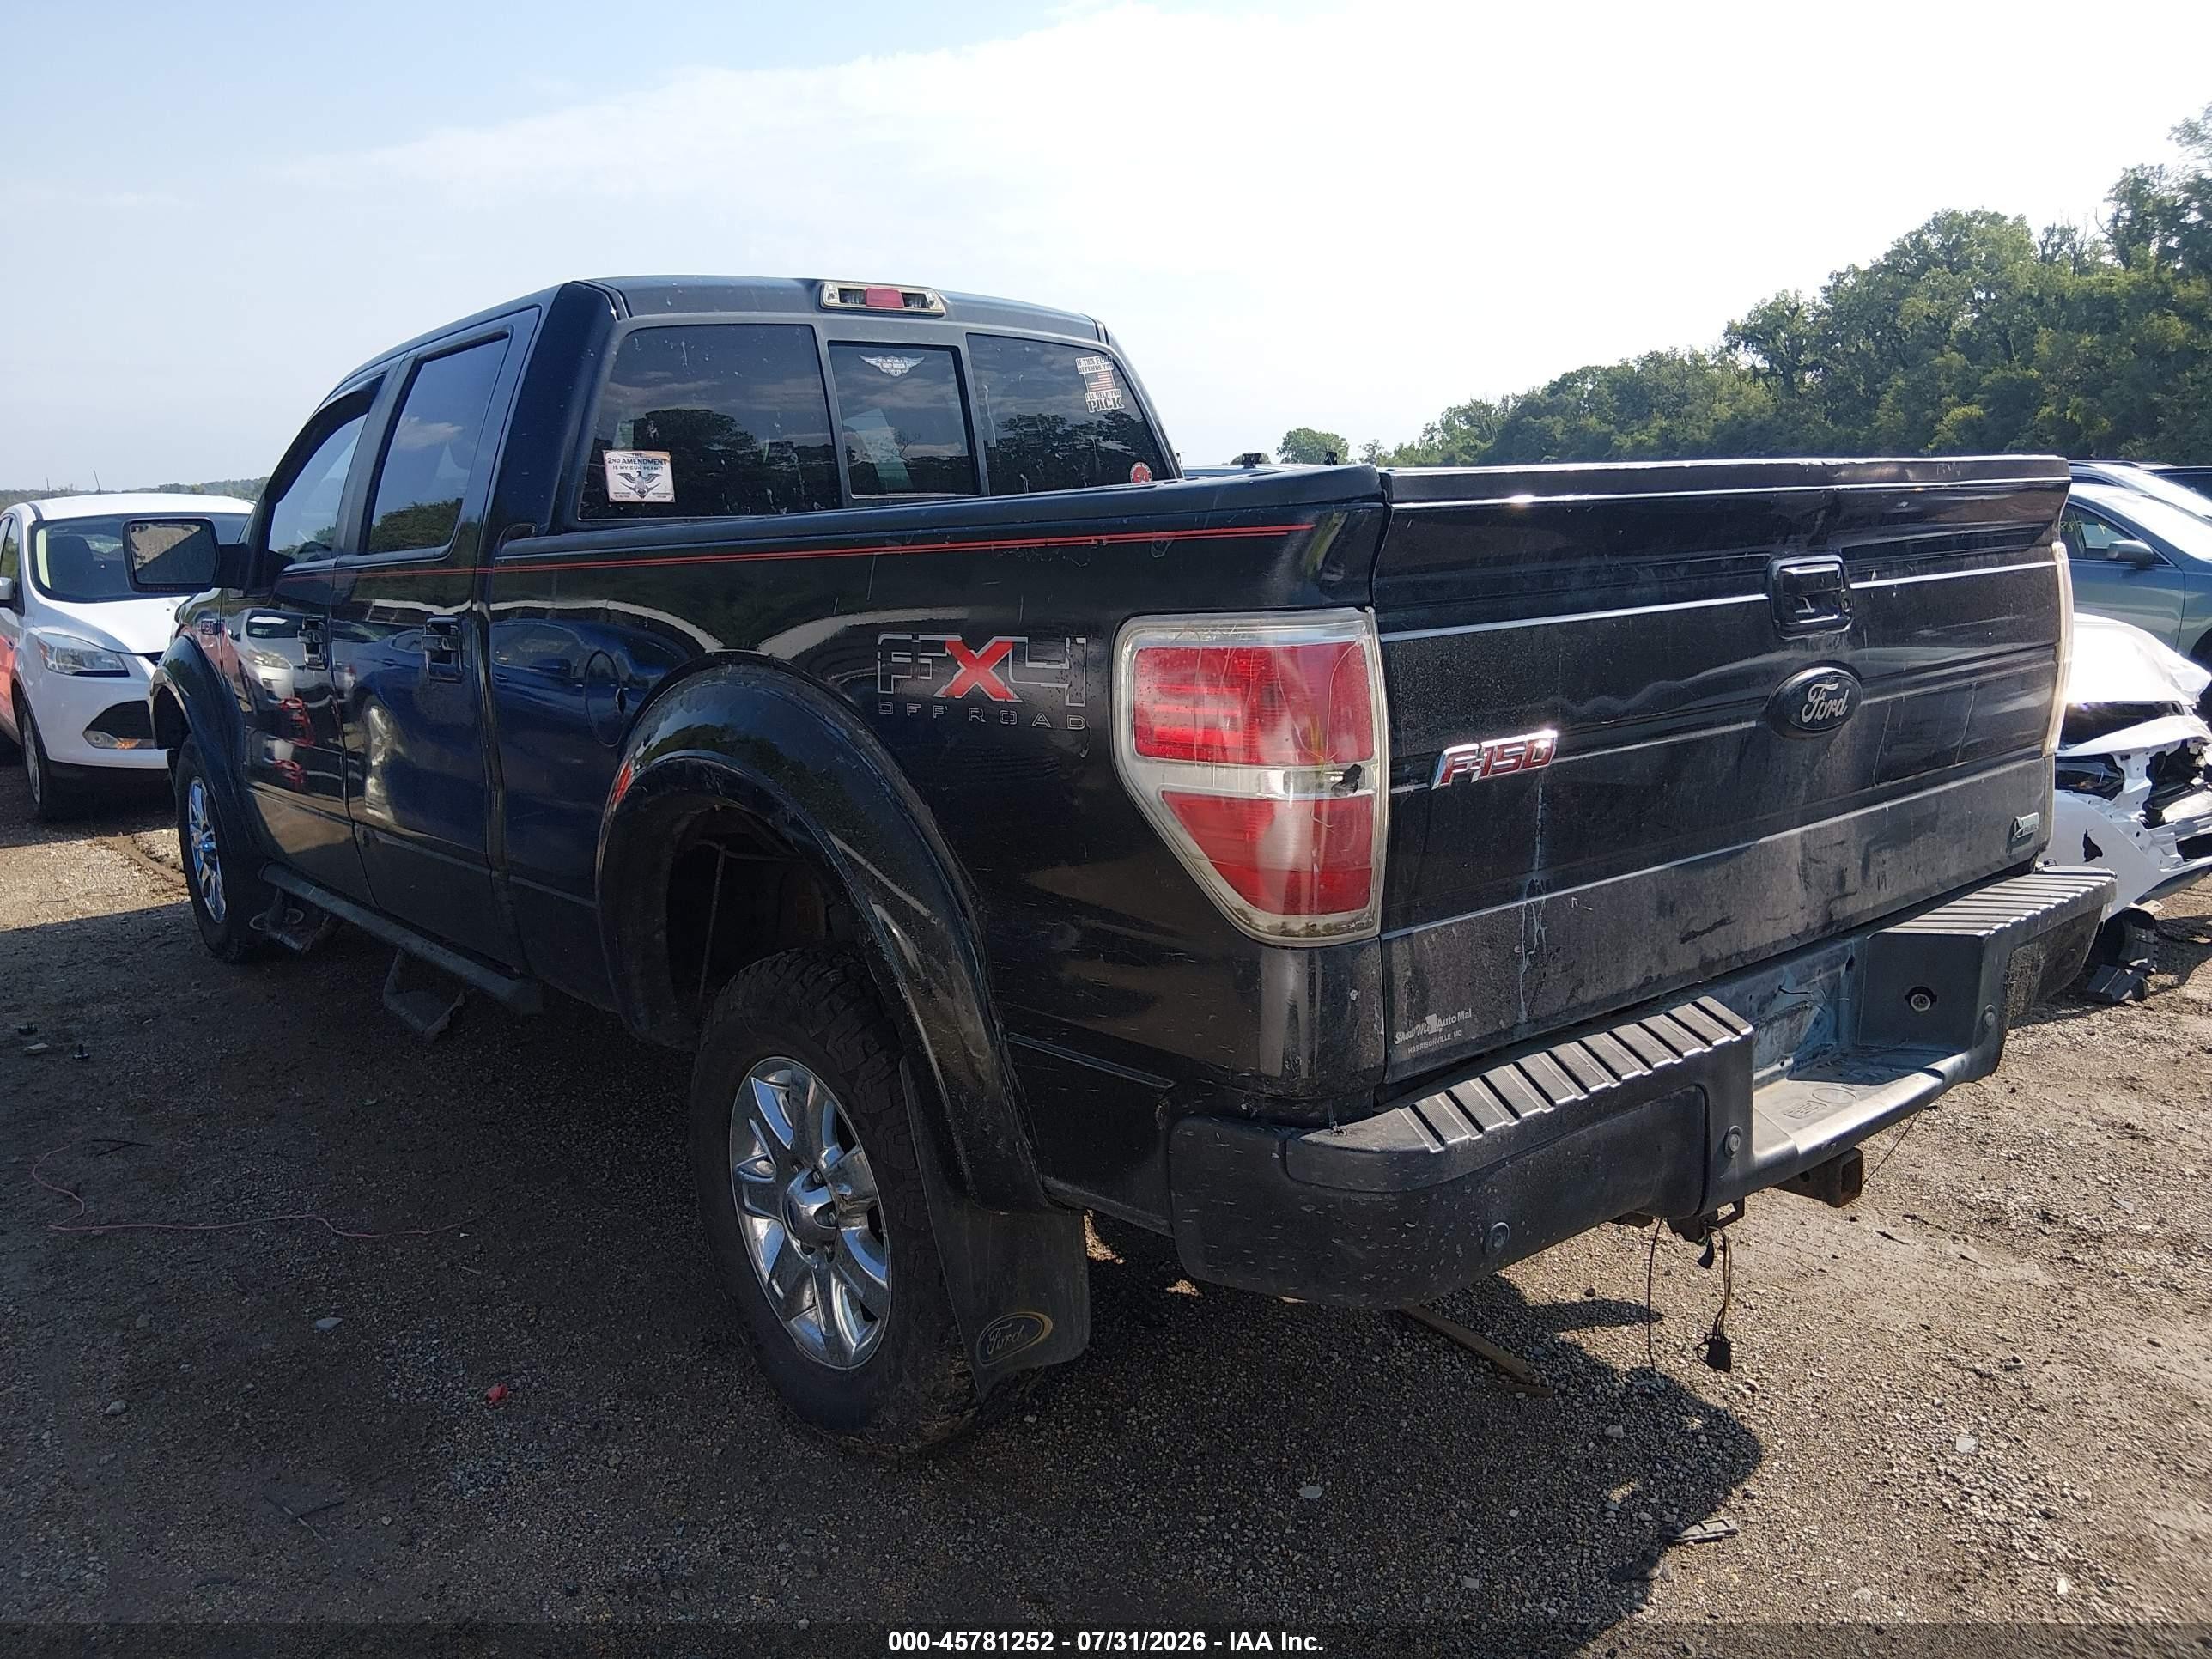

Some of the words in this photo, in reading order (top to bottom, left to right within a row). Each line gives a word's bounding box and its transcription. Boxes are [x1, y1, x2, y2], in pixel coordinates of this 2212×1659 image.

[1087, 396, 1123, 411] PACK
[878, 633, 1086, 707] FX4
[1801, 683, 1850, 722] Ford
[1431, 729, 1559, 790] F-150
[1437, 1015, 1457, 1030] Auto
[1407, 1032, 1452, 1054] HARRISONVILLE
[988, 1323, 1024, 1355] Ford
